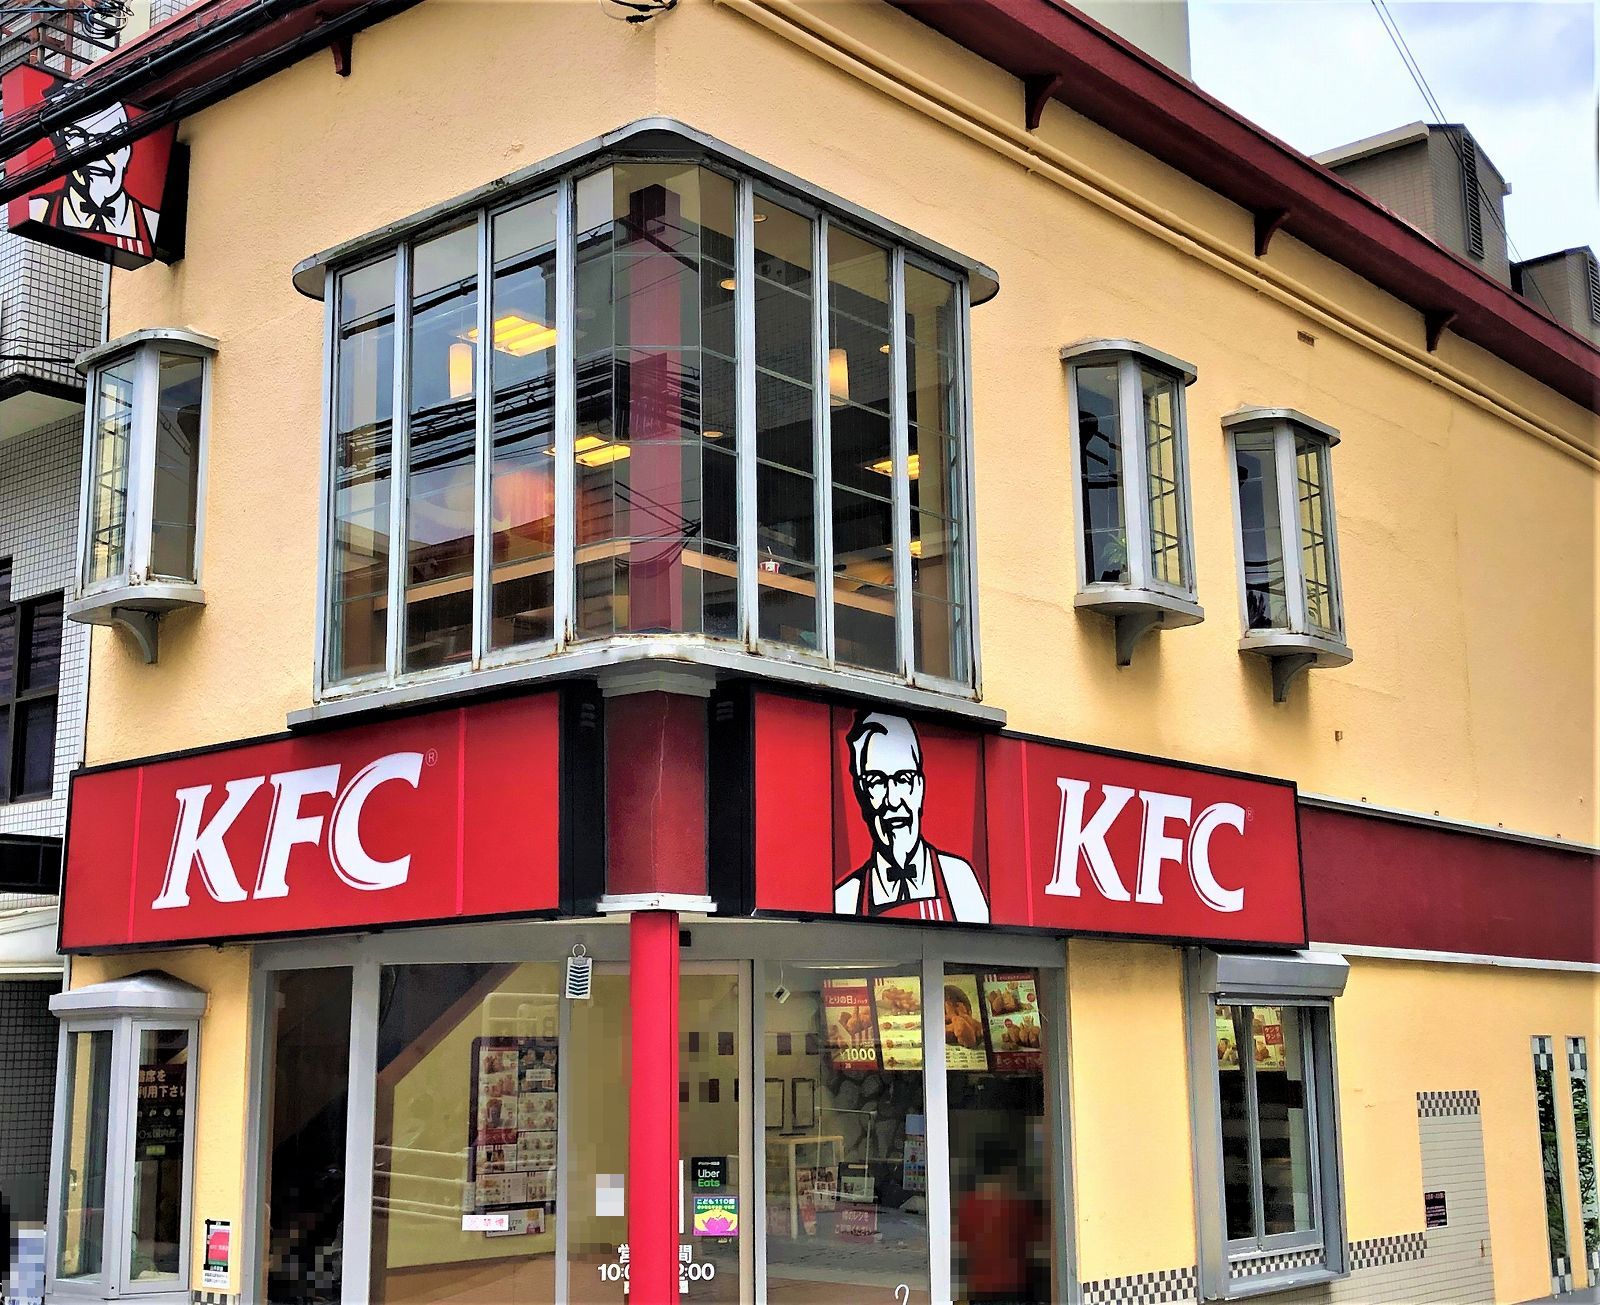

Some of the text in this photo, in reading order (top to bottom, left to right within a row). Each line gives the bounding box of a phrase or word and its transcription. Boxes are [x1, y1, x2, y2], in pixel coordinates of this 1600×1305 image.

[151, 752, 425, 911] KFC
[1044, 776, 1246, 913] KFC
[697, 1169, 720, 1178] Uber
[697, 1179, 720, 1187] Eats
